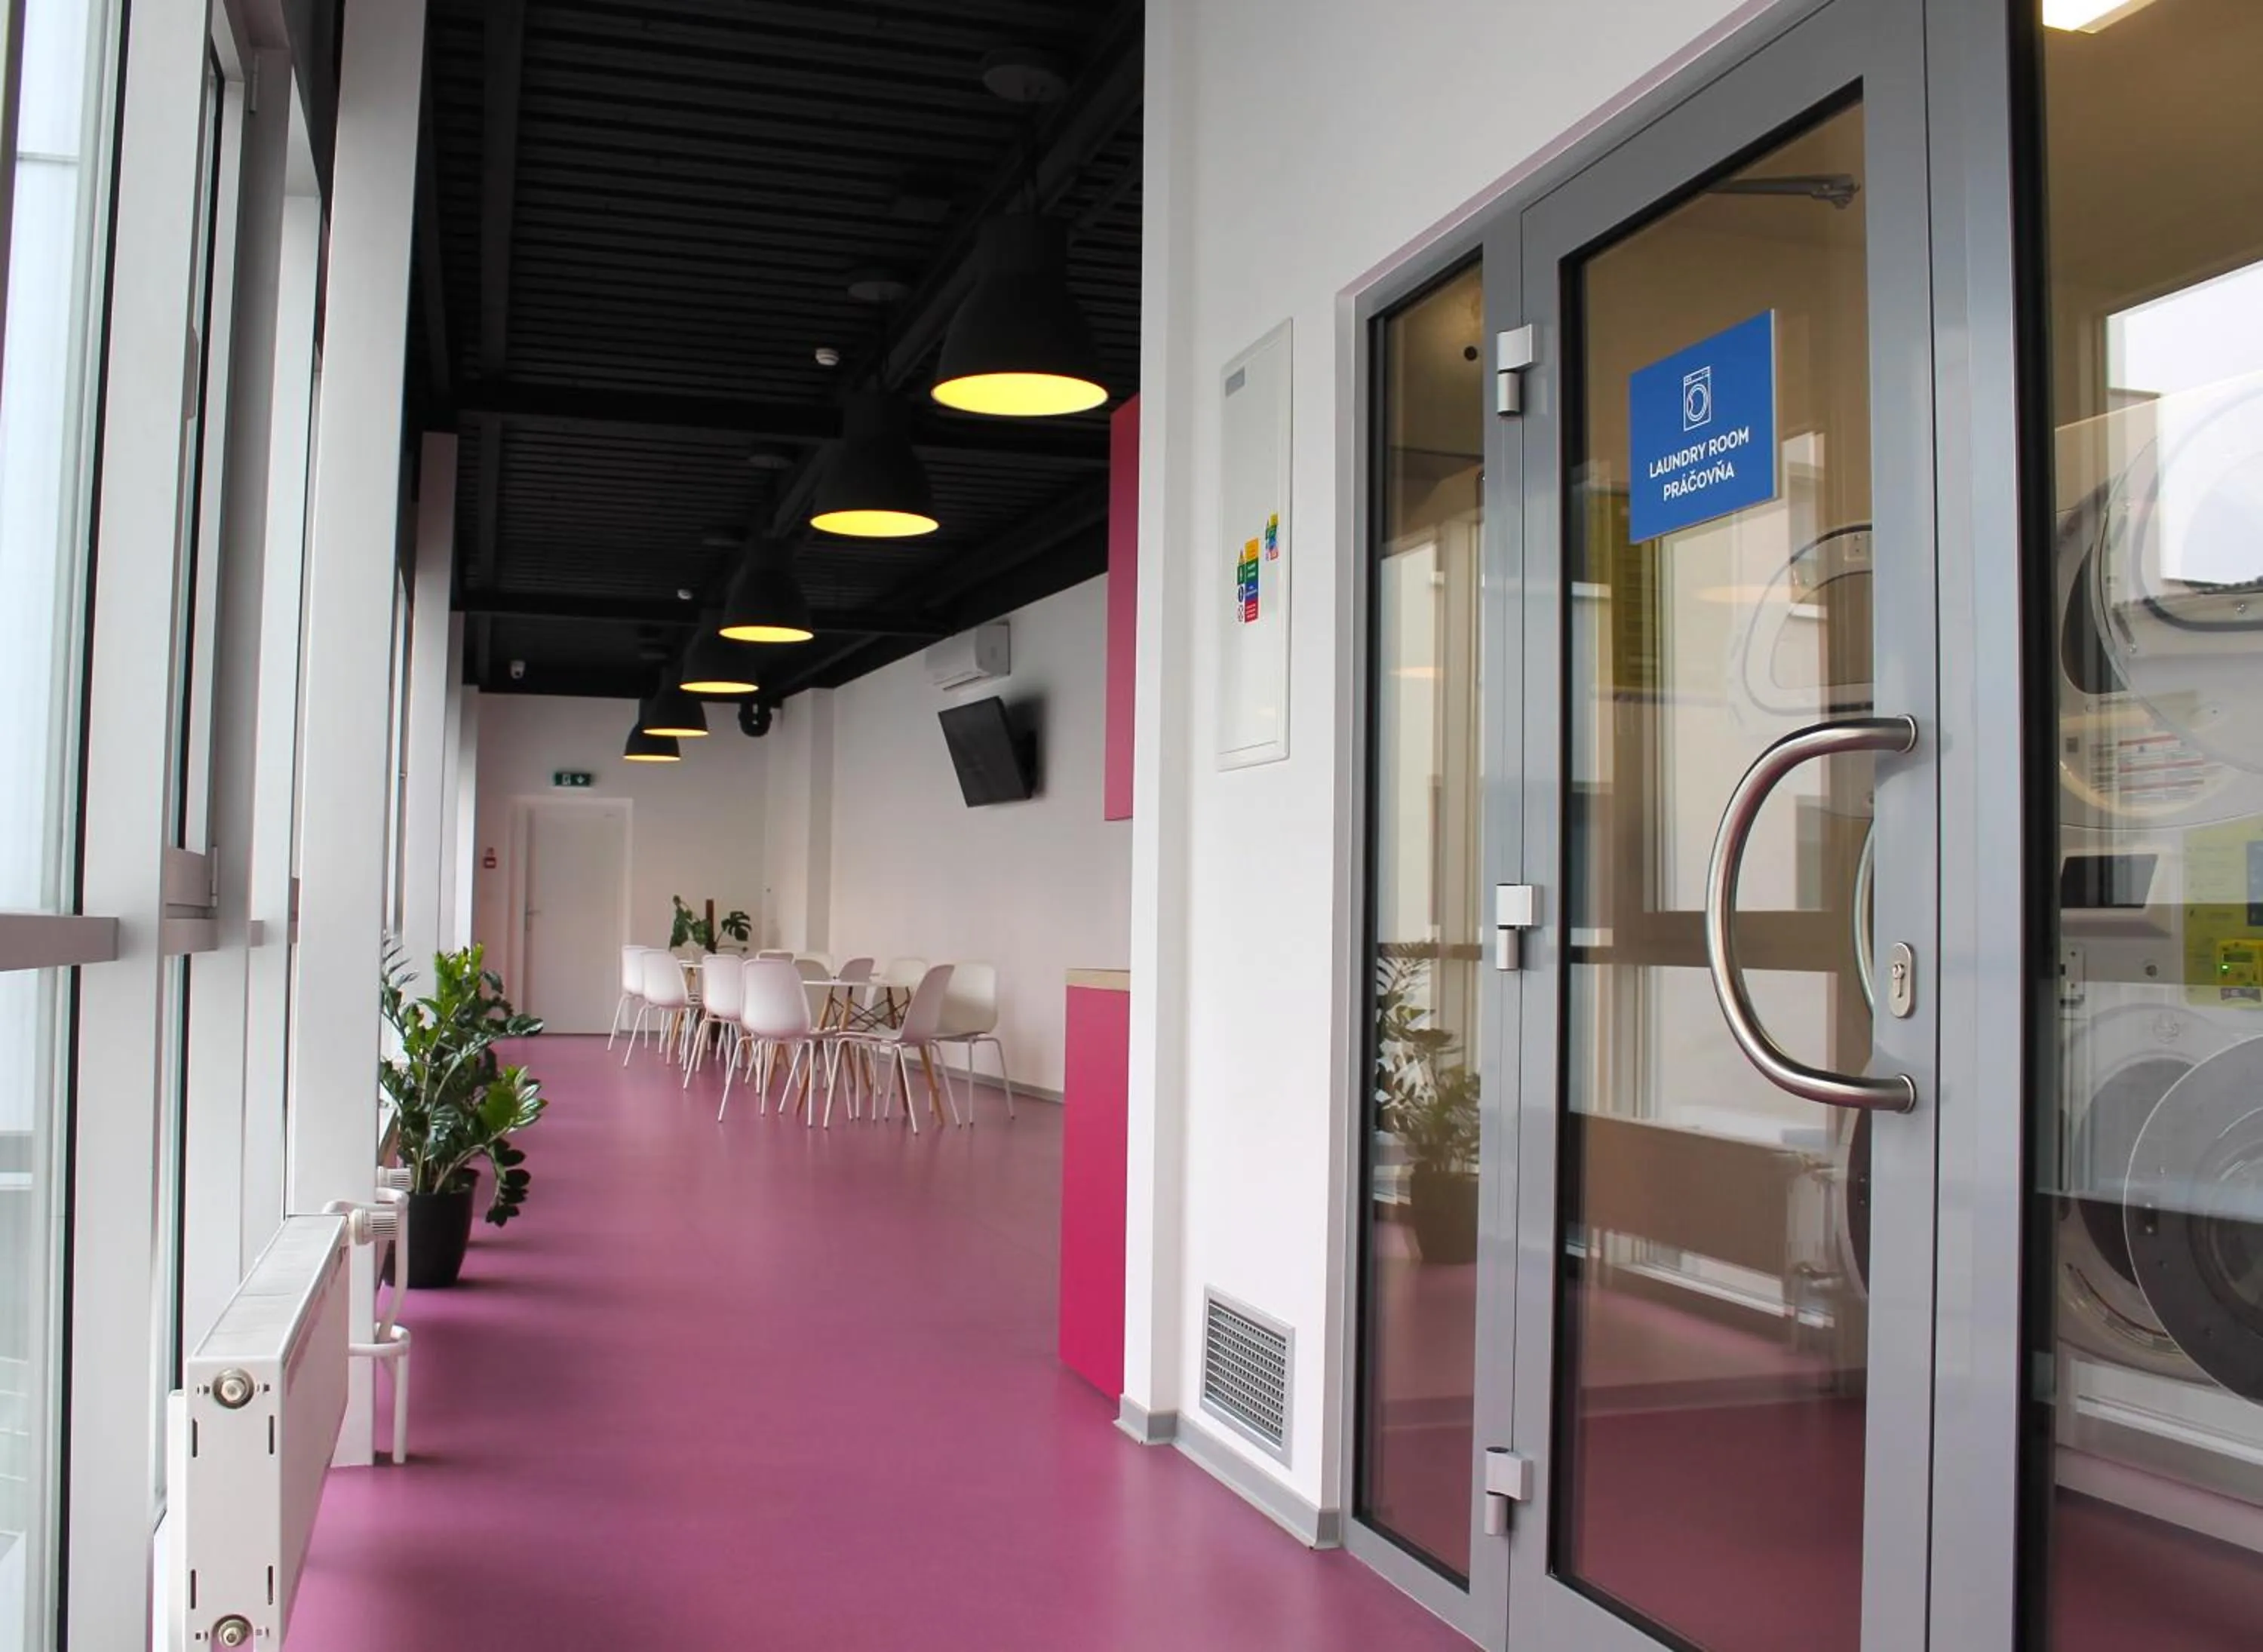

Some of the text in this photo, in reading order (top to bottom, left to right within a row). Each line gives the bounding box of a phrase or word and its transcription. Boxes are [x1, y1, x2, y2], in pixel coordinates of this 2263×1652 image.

[1649, 426, 1750, 478] LAUNDRY ROOM
[1663, 460, 1735, 501] PRÁČOVŇA
